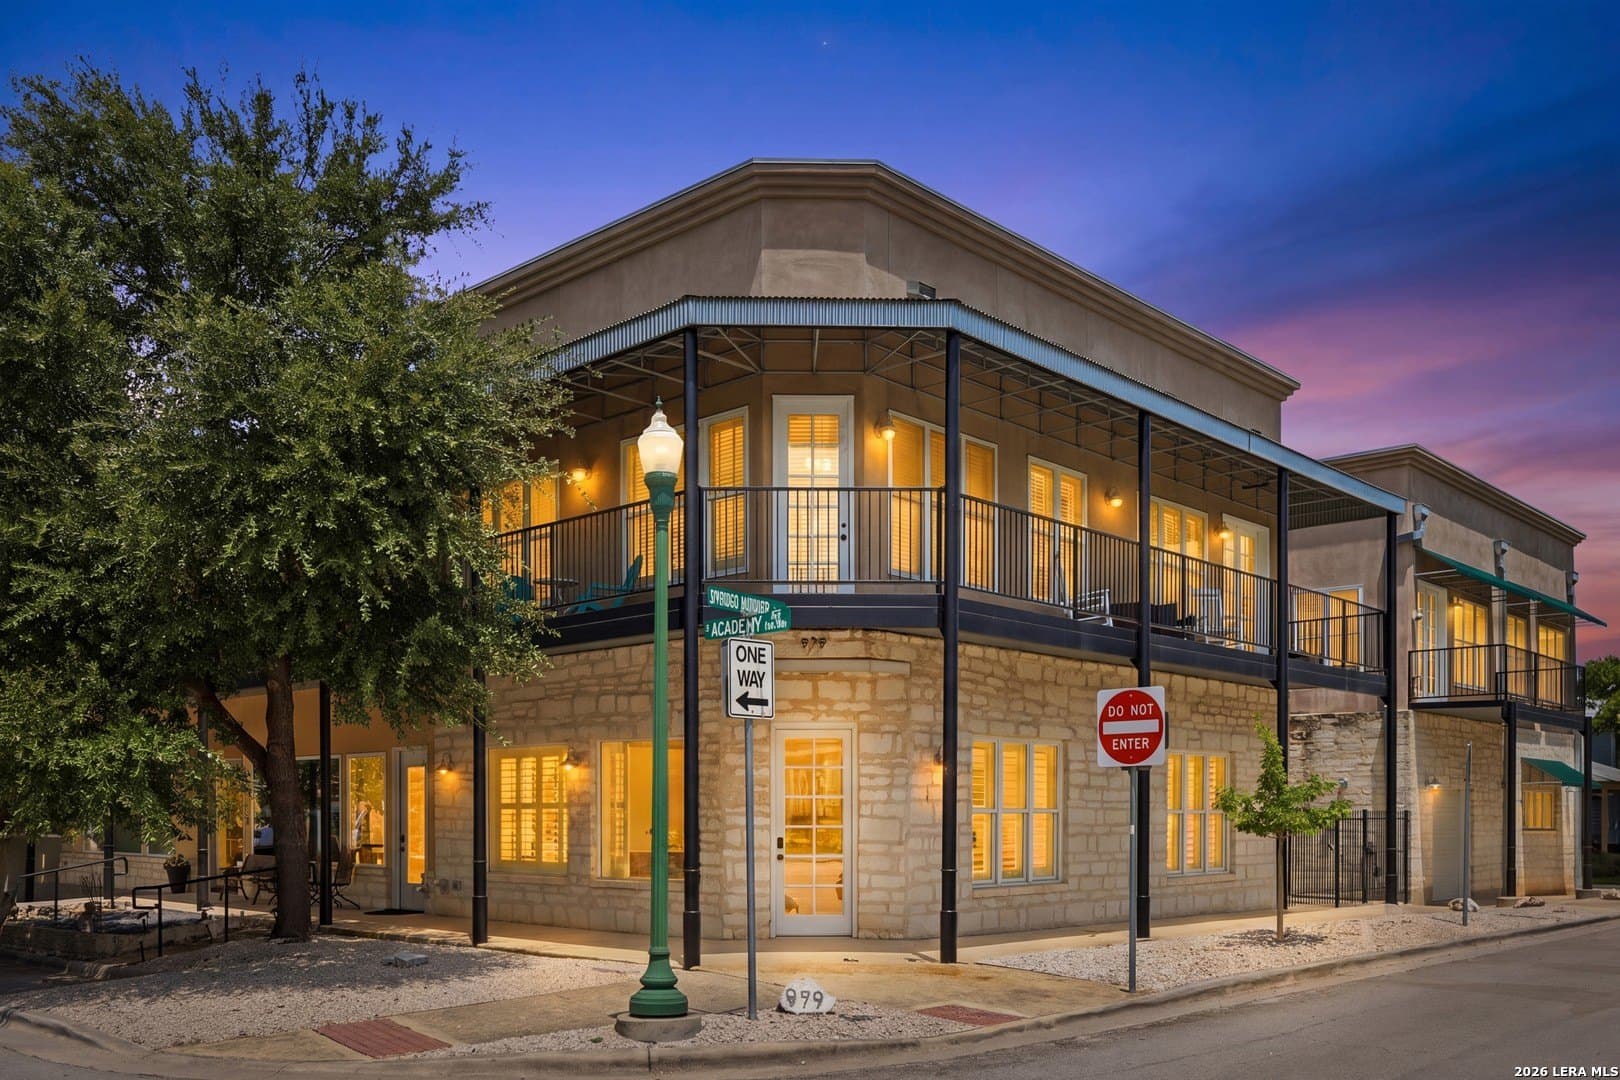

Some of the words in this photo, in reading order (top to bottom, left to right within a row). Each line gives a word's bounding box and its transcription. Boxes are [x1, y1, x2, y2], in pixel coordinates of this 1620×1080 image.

[711, 615, 762, 637] ACADEMY
[736, 645, 766, 664] ONE
[737, 669, 765, 688] WAY
[1108, 705, 1124, 718] DO
[1130, 703, 1154, 716] NOT
[1112, 737, 1149, 751] ENTER
